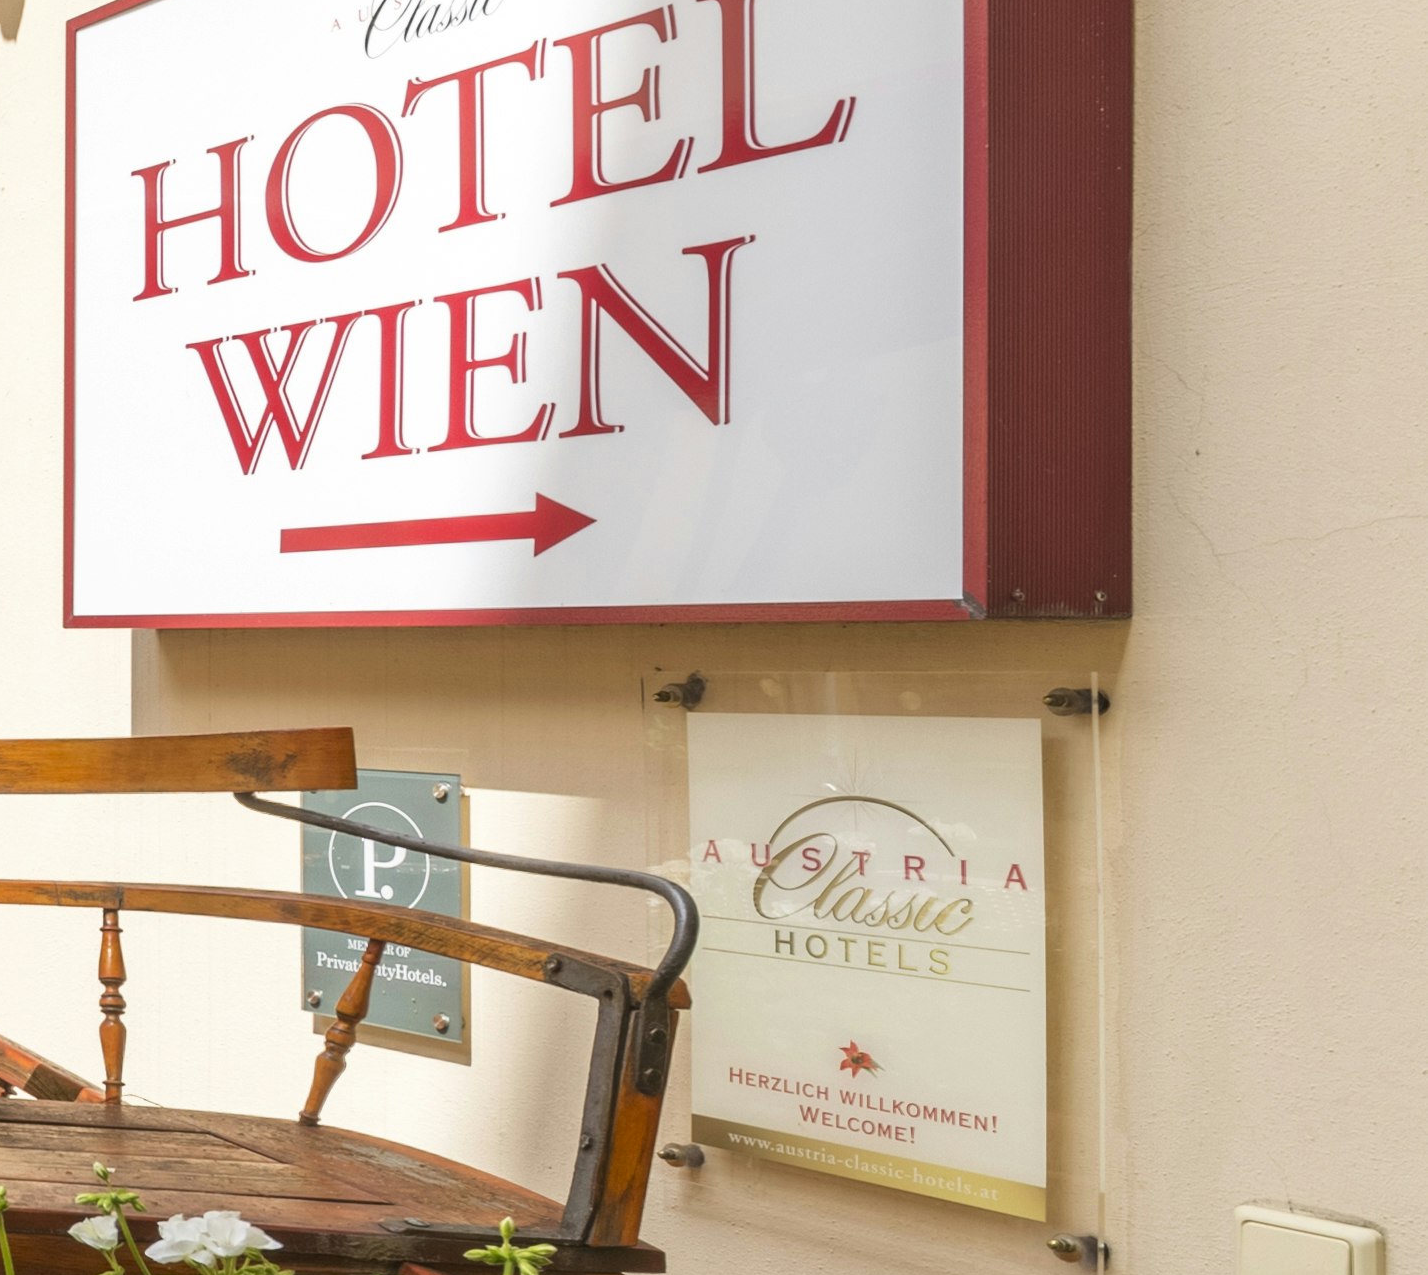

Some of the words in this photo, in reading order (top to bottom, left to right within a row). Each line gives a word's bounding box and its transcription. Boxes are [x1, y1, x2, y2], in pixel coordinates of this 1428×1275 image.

[186, 233, 756, 475] WIEN
[702, 839, 1029, 892] AUSTRIA
[753, 832, 975, 937] Classic
[395, 946, 411, 958] OF
[774, 929, 953, 976] HOTELS
[729, 1066, 830, 1102] HERZLICH
[839, 1089, 999, 1134] WILLKOMMEN!
[798, 1104, 916, 1144] WELCOME!
[727, 1132, 999, 1202] www.austria-classic-hotels.at
